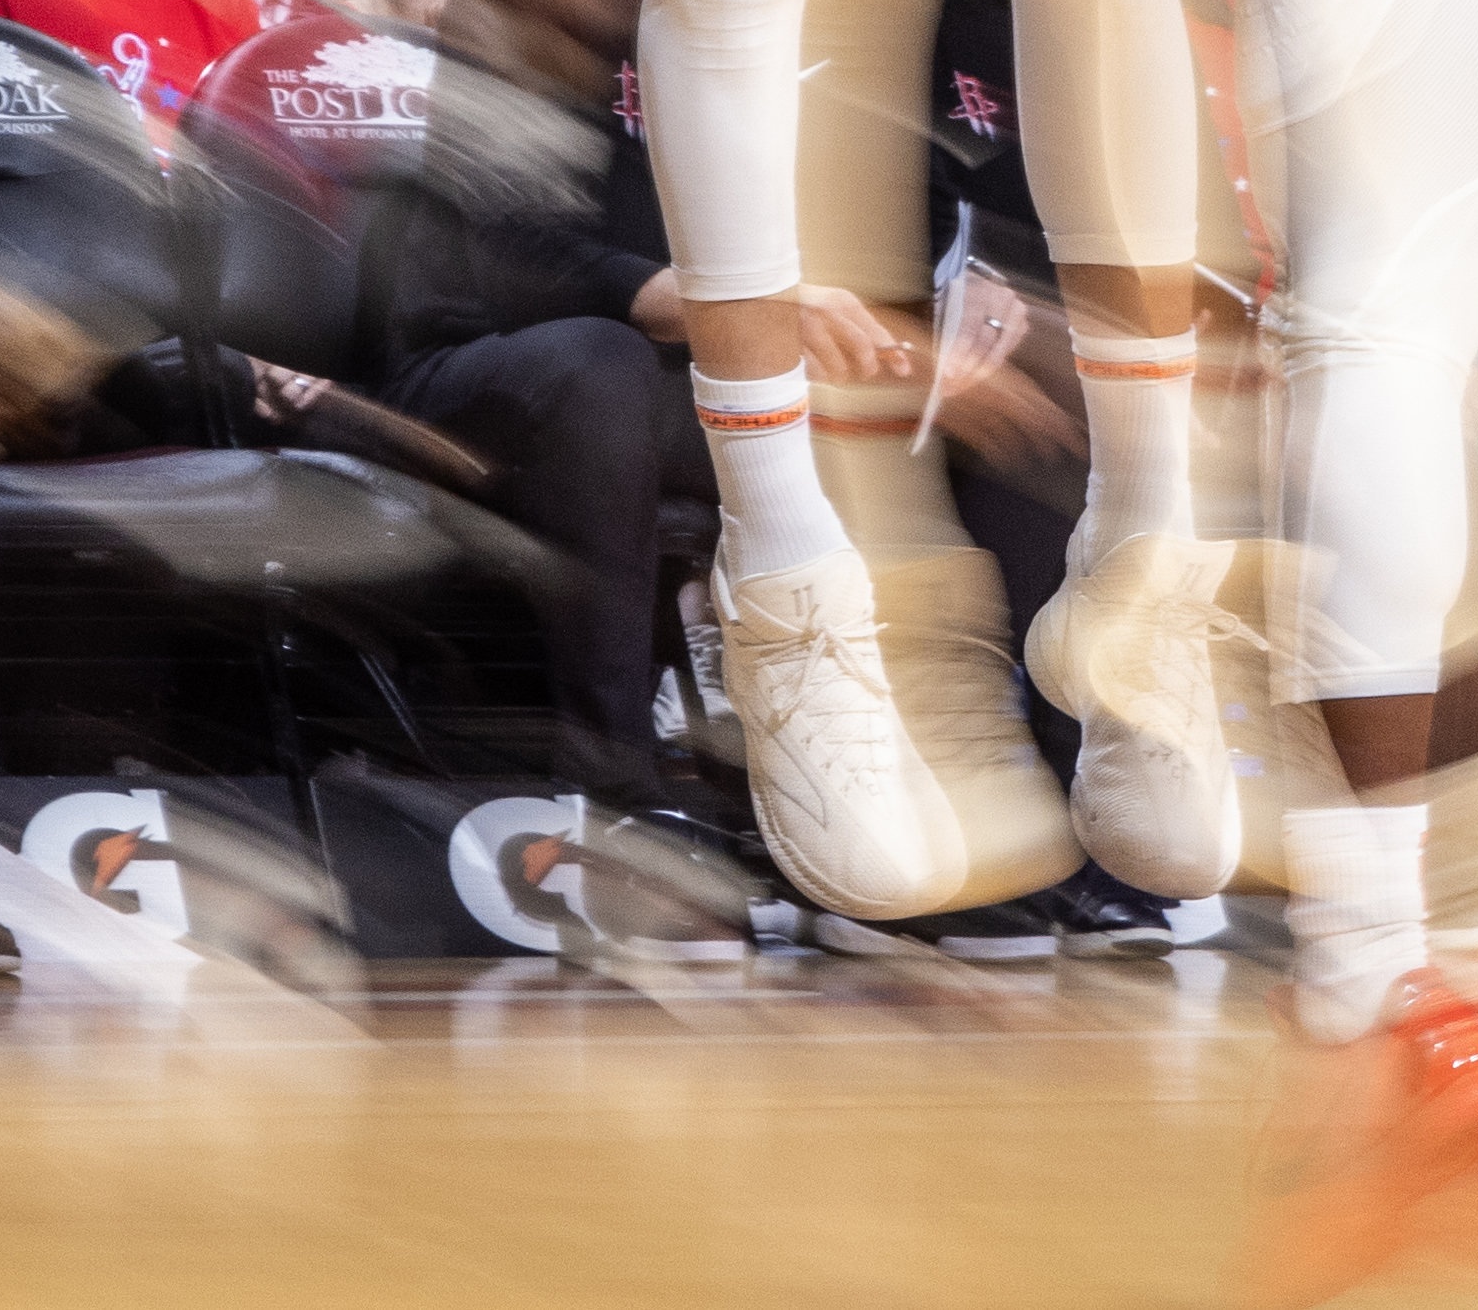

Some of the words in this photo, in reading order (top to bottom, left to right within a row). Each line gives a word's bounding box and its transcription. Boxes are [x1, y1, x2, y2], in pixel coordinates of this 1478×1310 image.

[264, 69, 299, 83] THE
[269, 87, 371, 118] POST
[289, 126, 328, 138] HOTEL
[333, 127, 349, 138] AT
[352, 128, 409, 139] UPTOWN
[22, 789, 189, 942] G
